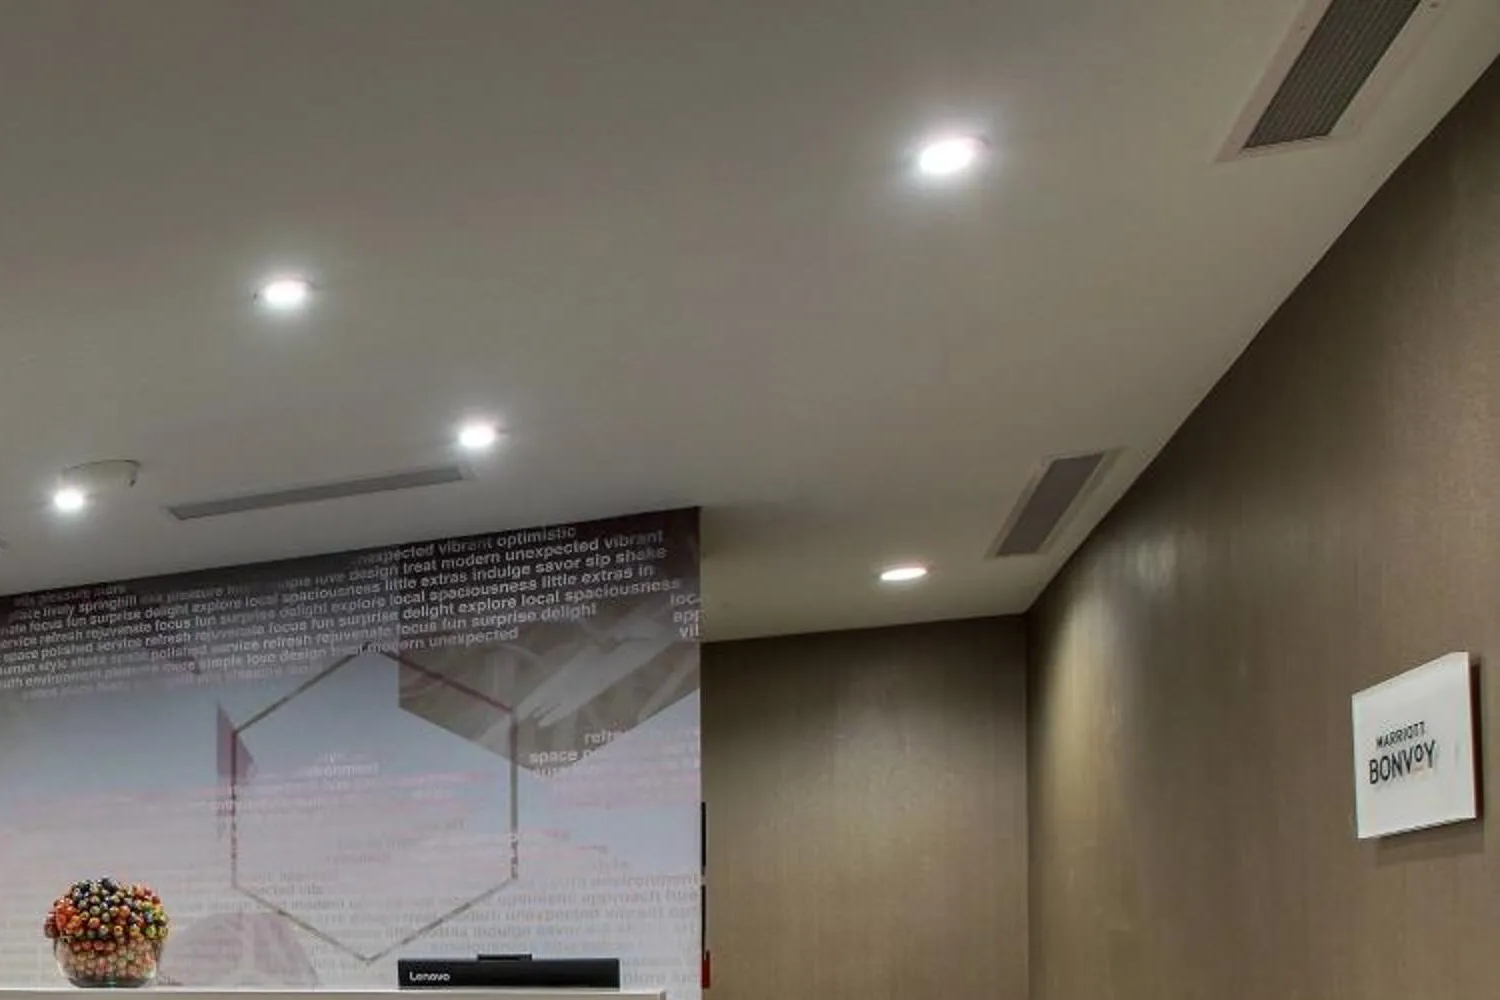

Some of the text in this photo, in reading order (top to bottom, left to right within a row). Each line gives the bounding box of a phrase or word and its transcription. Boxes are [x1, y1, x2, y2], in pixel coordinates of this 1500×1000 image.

[442, 554, 499, 569] modern
[505, 538, 599, 561] unexpected
[604, 530, 663, 549] vibrant
[497, 526, 576, 548] optimistic
[67, 617, 87, 627] fun
[385, 576, 417, 590] little
[420, 573, 468, 586] extras
[472, 564, 531, 580] indulge
[535, 560, 581, 573] savor
[585, 554, 611, 568] sip
[615, 547, 667, 563] shake
[155, 620, 191, 631] focus
[195, 616, 217, 627] fun
[331, 598, 386, 612] explore
[389, 590, 425, 605] local
[429, 580, 537, 602] spaciousness
[541, 573, 577, 588] little
[581, 569, 633, 583] extras
[311, 617, 335, 629] fun
[403, 602, 453, 619] delight
[457, 598, 517, 614] explore
[521, 591, 560, 606] local
[564, 580, 682, 603] spaciousness
[395, 623, 438, 635] focus
[442, 619, 467, 630] fun
[471, 611, 537, 628] surprise
[541, 603, 597, 620] delight
[1376, 721, 1425, 749] MARRIOTT
[529, 750, 577, 765] space
[1369, 740, 1436, 785] BONVOY
[409, 971, 451, 981] Lenovo
